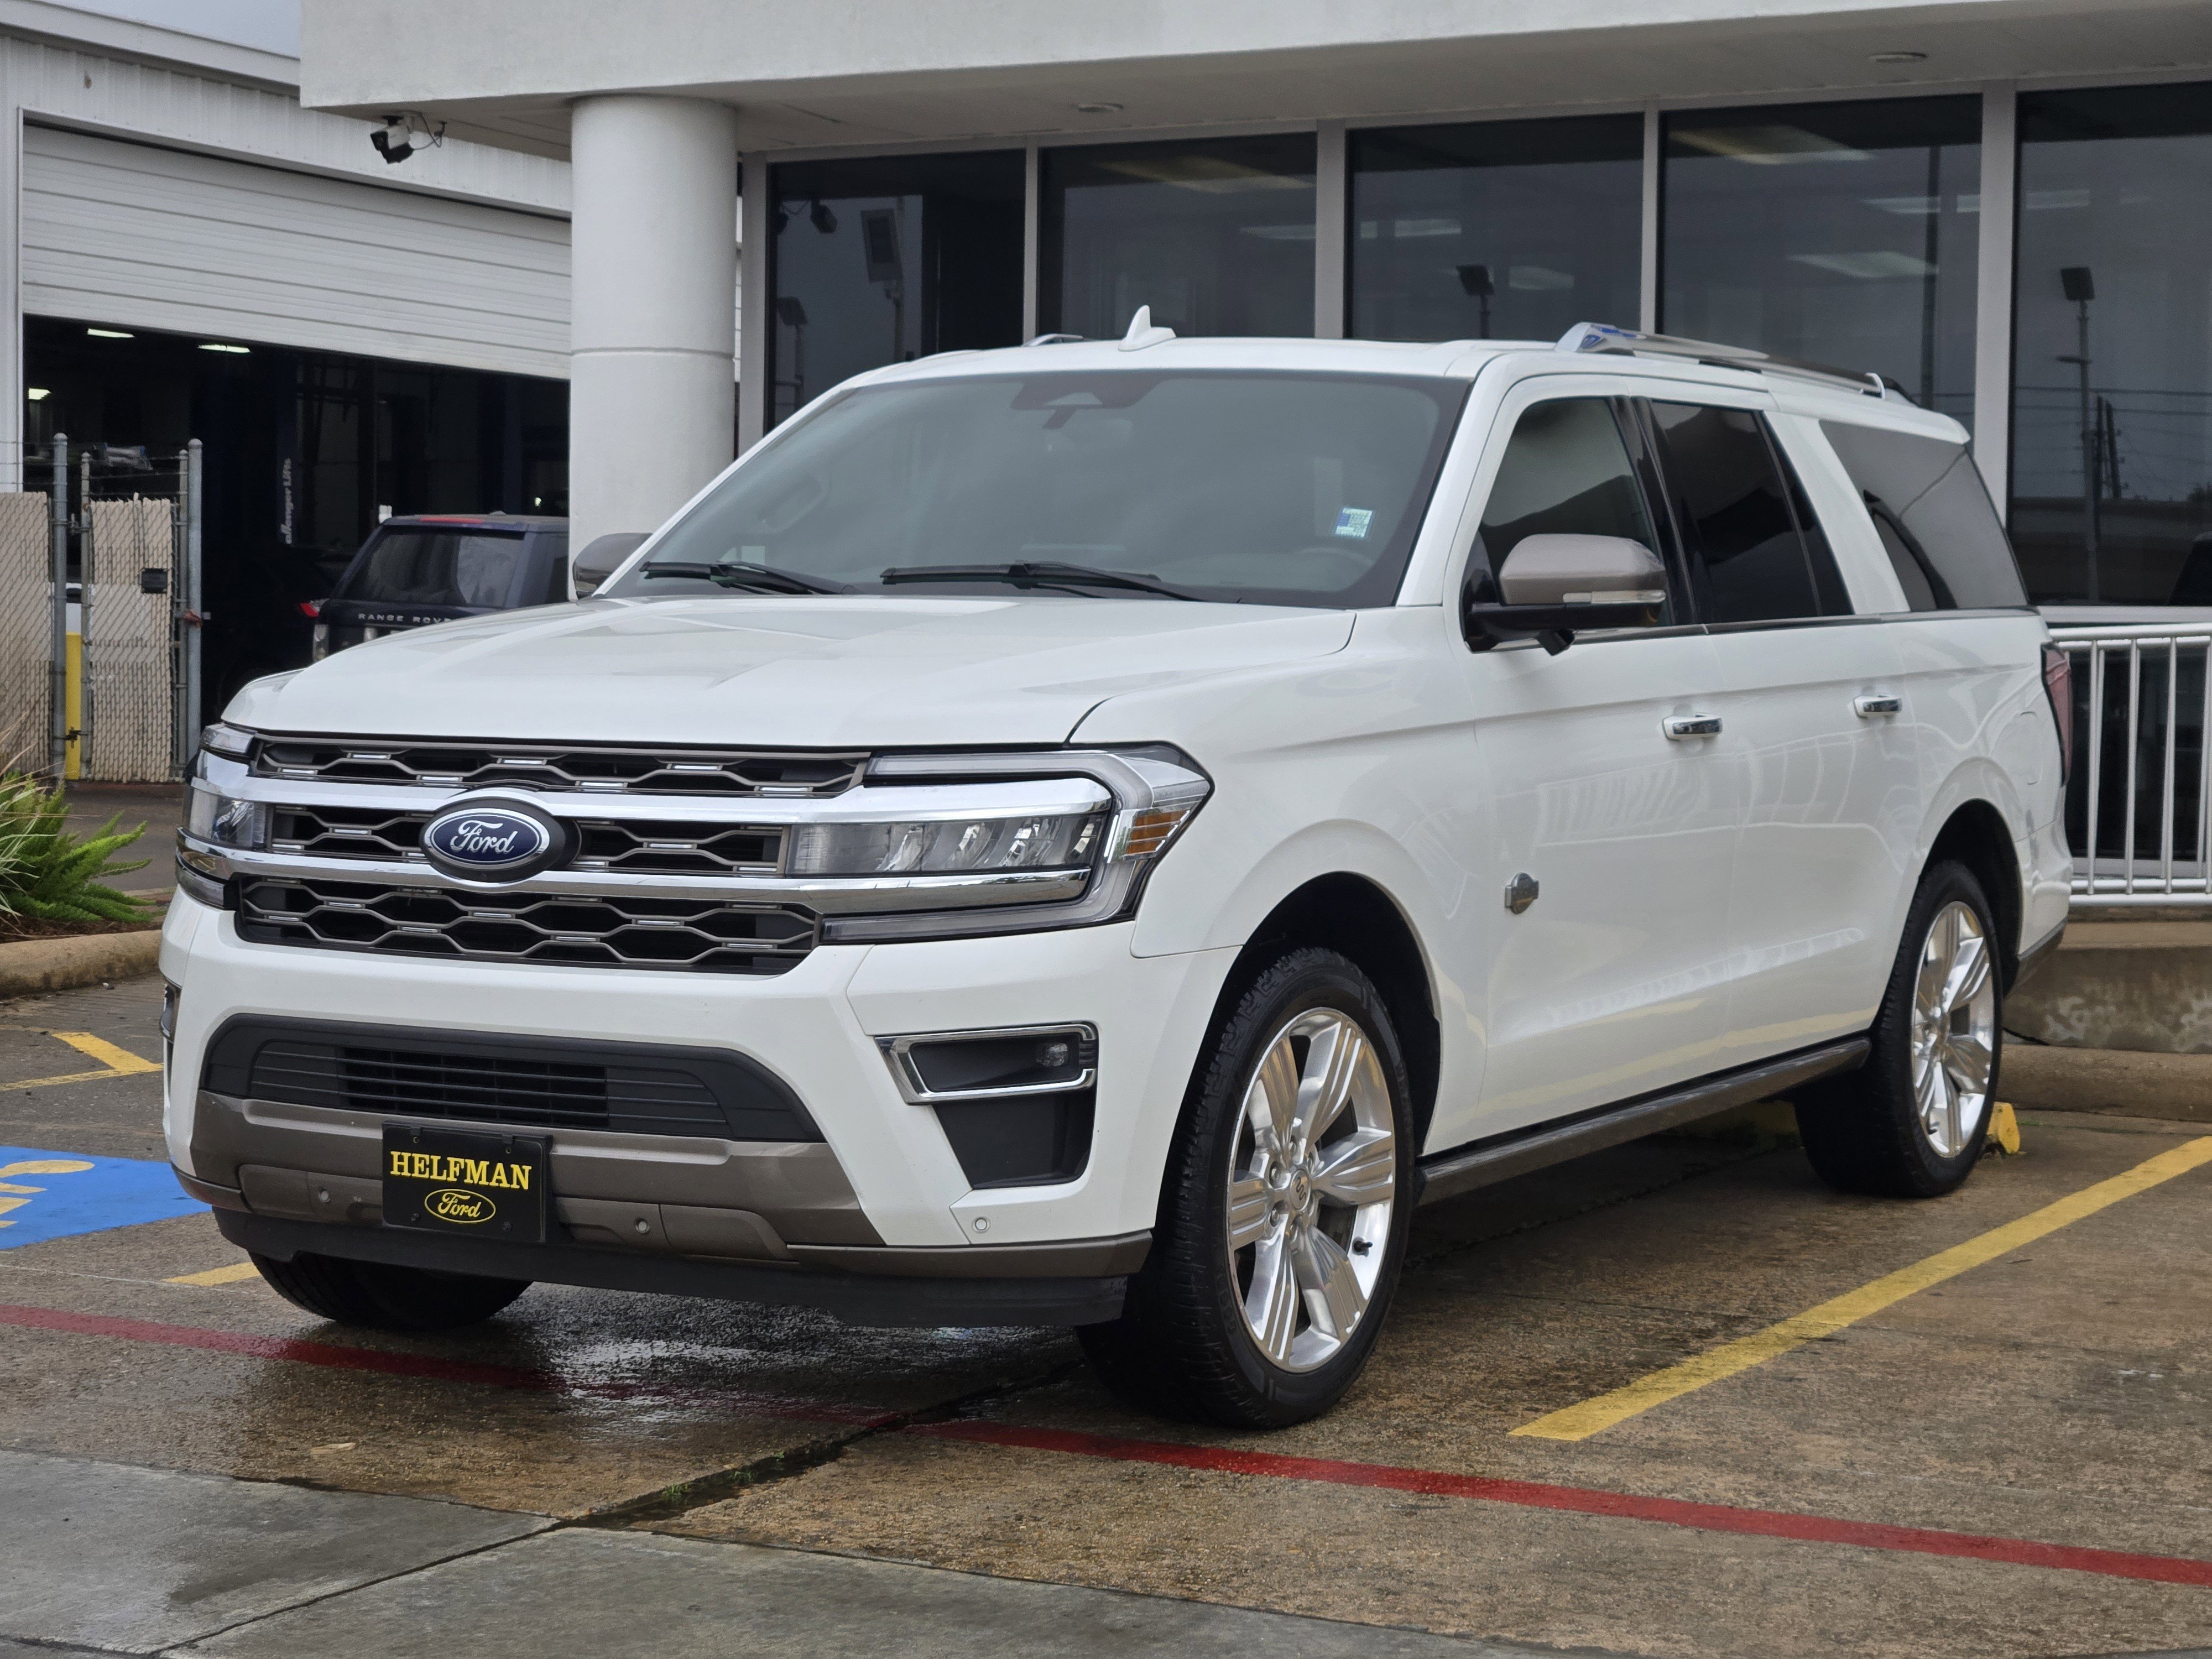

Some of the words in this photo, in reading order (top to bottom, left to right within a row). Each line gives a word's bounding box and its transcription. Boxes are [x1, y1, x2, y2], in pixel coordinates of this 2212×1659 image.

[358, 613, 404, 622] RANGE
[450, 820, 518, 854] Ford
[390, 1151, 532, 1191] HELFMAN
[437, 1192, 482, 1218] Ford
